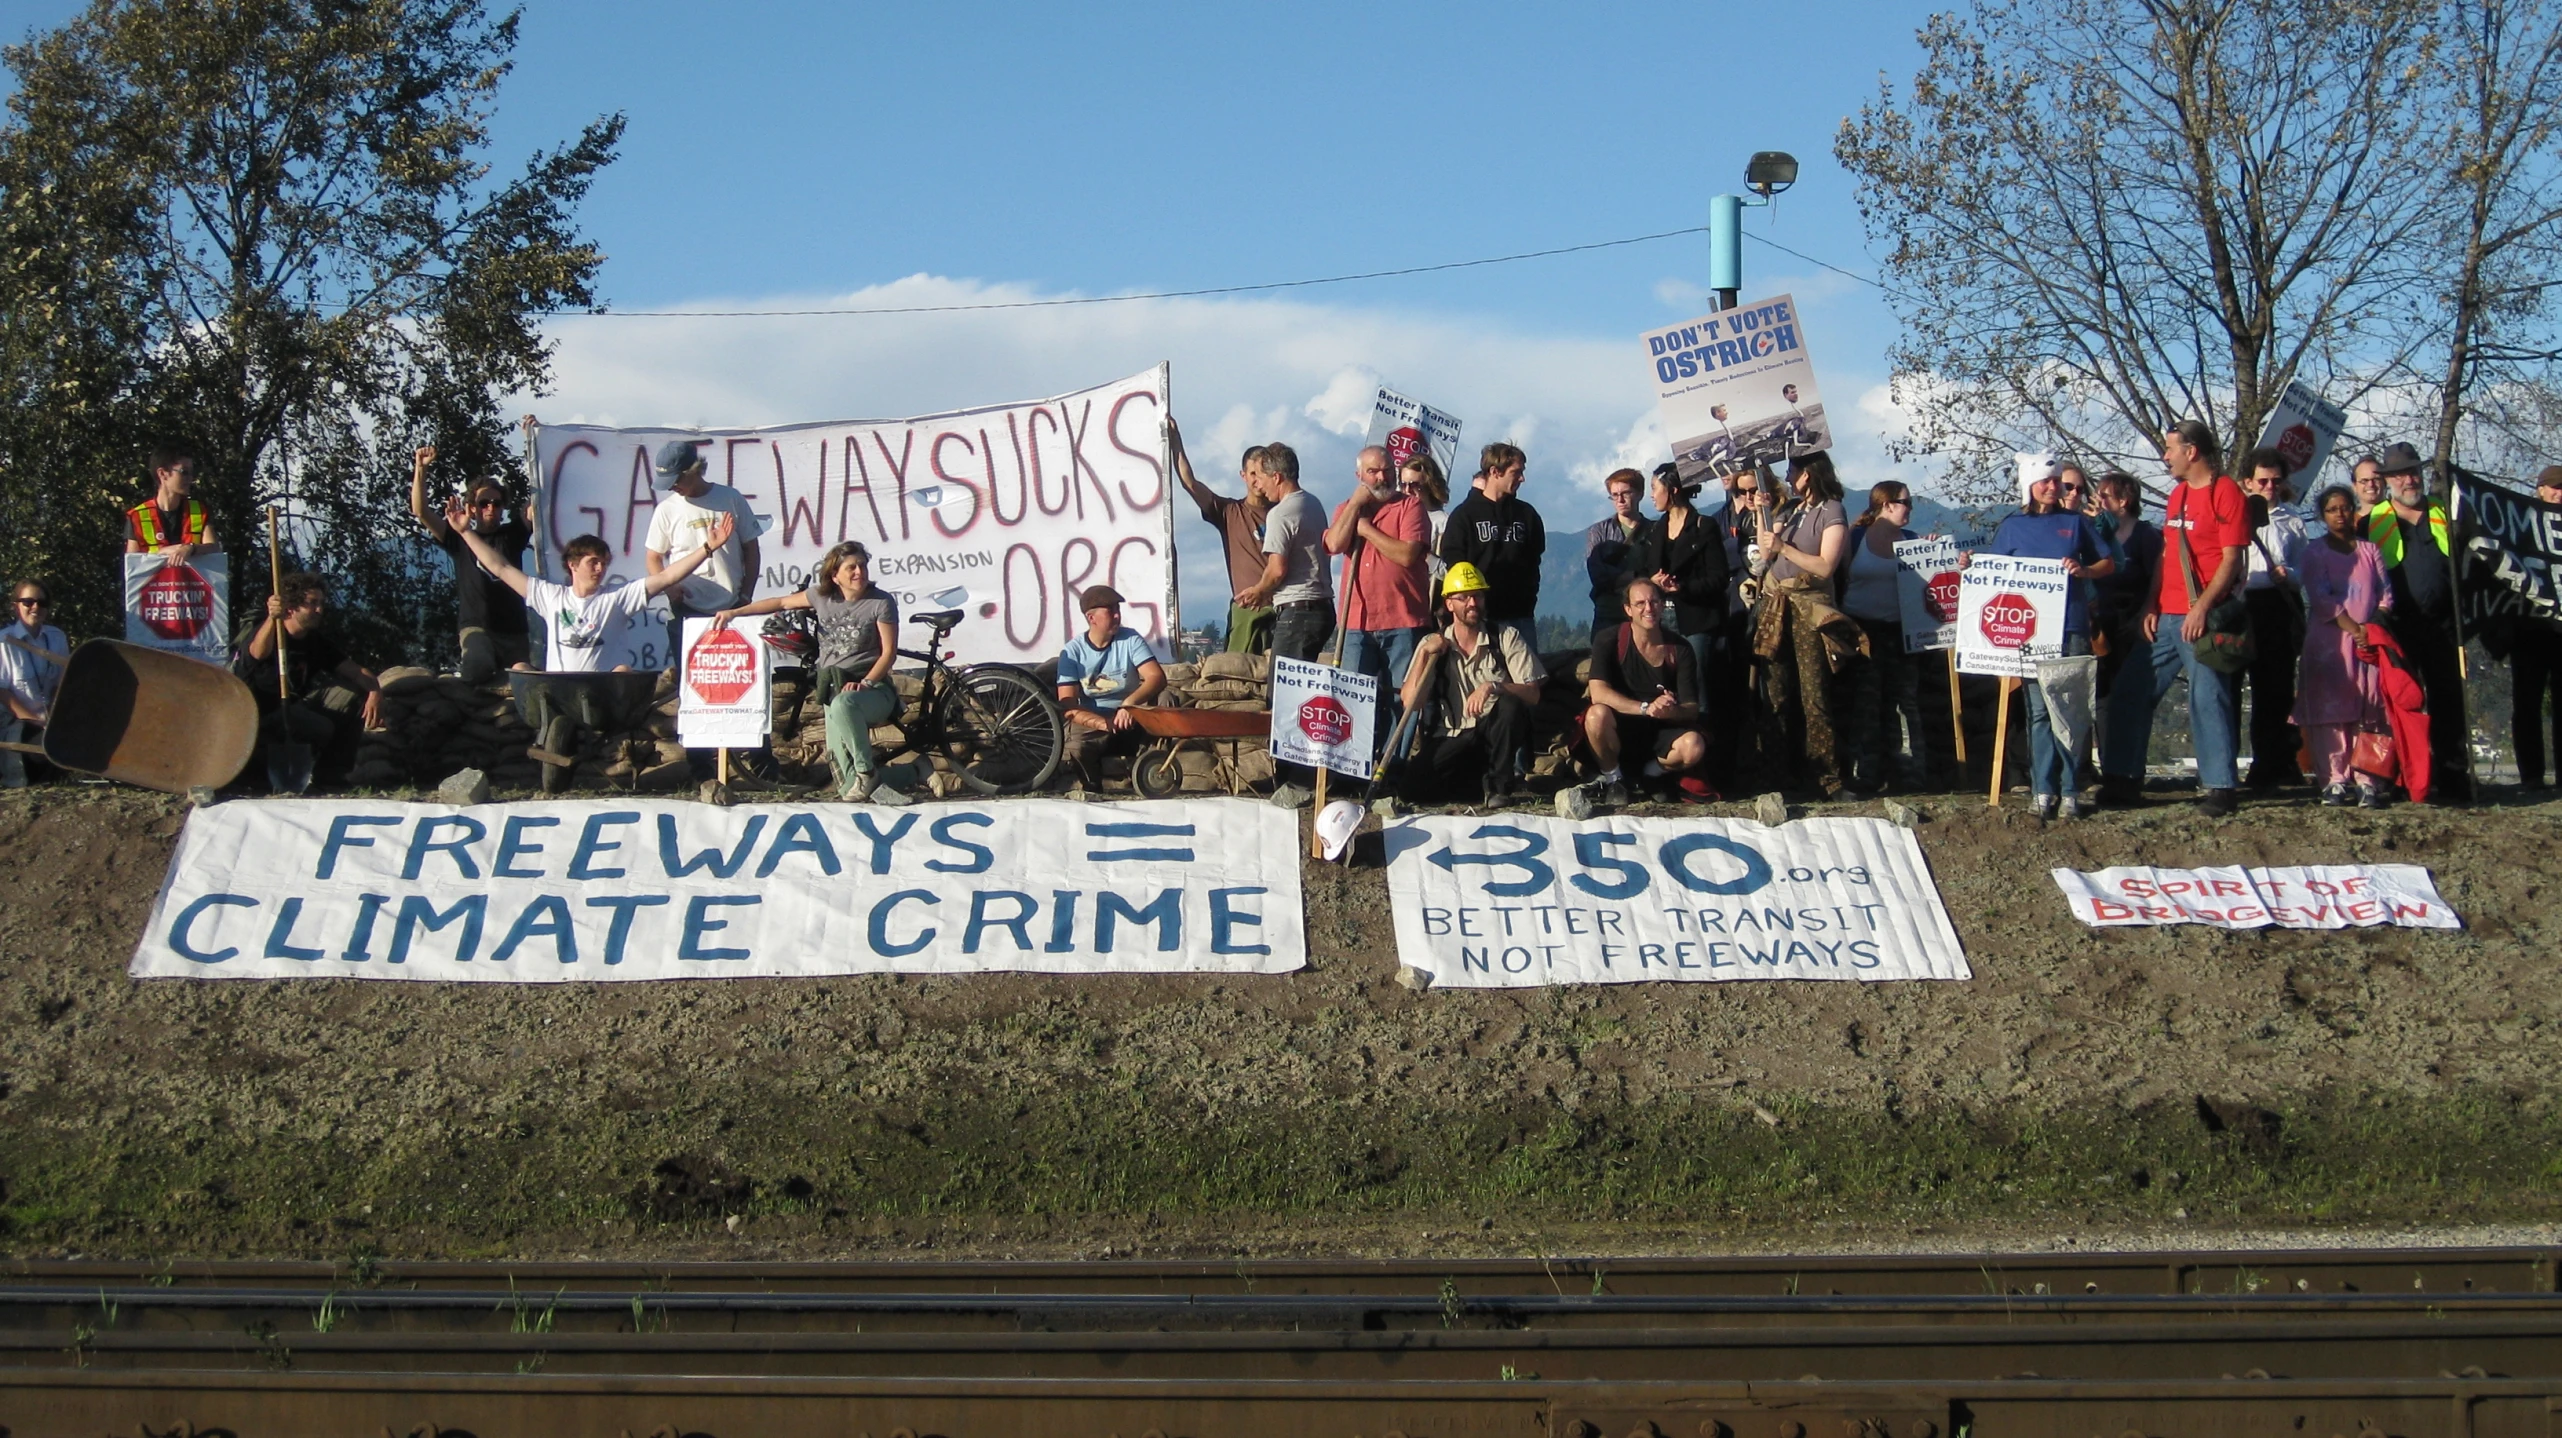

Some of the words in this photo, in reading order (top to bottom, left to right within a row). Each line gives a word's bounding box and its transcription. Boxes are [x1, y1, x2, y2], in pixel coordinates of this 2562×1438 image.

[1648, 320, 1720, 356] DON'T
[1727, 302, 1792, 334] VOTE
[1656, 324, 1799, 384] OSTRICH
[1378, 389, 1417, 411] Better
[1420, 404, 1460, 431] Transit
[1375, 401, 1397, 418] Not
[1400, 411, 1457, 443] Freeways
[1389, 433, 1430, 456] STOP
[2282, 430, 2314, 454] STOP
[1896, 542, 1937, 558] Better
[1940, 535, 1986, 551] Transit
[879, 550, 994, 577] EXPANSION
[1897, 559, 1922, 572] Not
[2014, 560, 2066, 575] Transit
[1963, 574, 1989, 587] Not
[1993, 576, 2065, 594] Freeways
[148, 590, 205, 604] TRUCKIN'
[145, 606, 209, 621] FREEWAYS!
[1983, 606, 2036, 624] STOP
[1990, 623, 2026, 635] Climate
[1993, 634, 2021, 646] Crime
[695, 652, 749, 667] TRUCKIN'
[690, 668, 753, 684] FREEWAYS!
[1277, 660, 1322, 676] Better
[1328, 668, 1376, 690] Transit
[1277, 674, 1302, 688] Not
[1307, 679, 1375, 703] Freeways
[1301, 705, 1351, 727] STOP
[1309, 721, 1342, 736] Climate
[1311, 732, 1339, 744] Crime
[1283, 751, 1358, 775] GatewaySucks.org
[315, 811, 995, 881] FREEWAYS
[1468, 824, 1872, 901] 350.org
[2305, 876, 2371, 895] OF
[168, 892, 763, 965] CLIMATE
[866, 887, 1272, 958] CRIME
[1422, 906, 1623, 937] BETTER
[1664, 902, 1885, 933] TRANSIT
[1461, 943, 1567, 974] NOT
[1602, 937, 1882, 970] FREEWAYS
